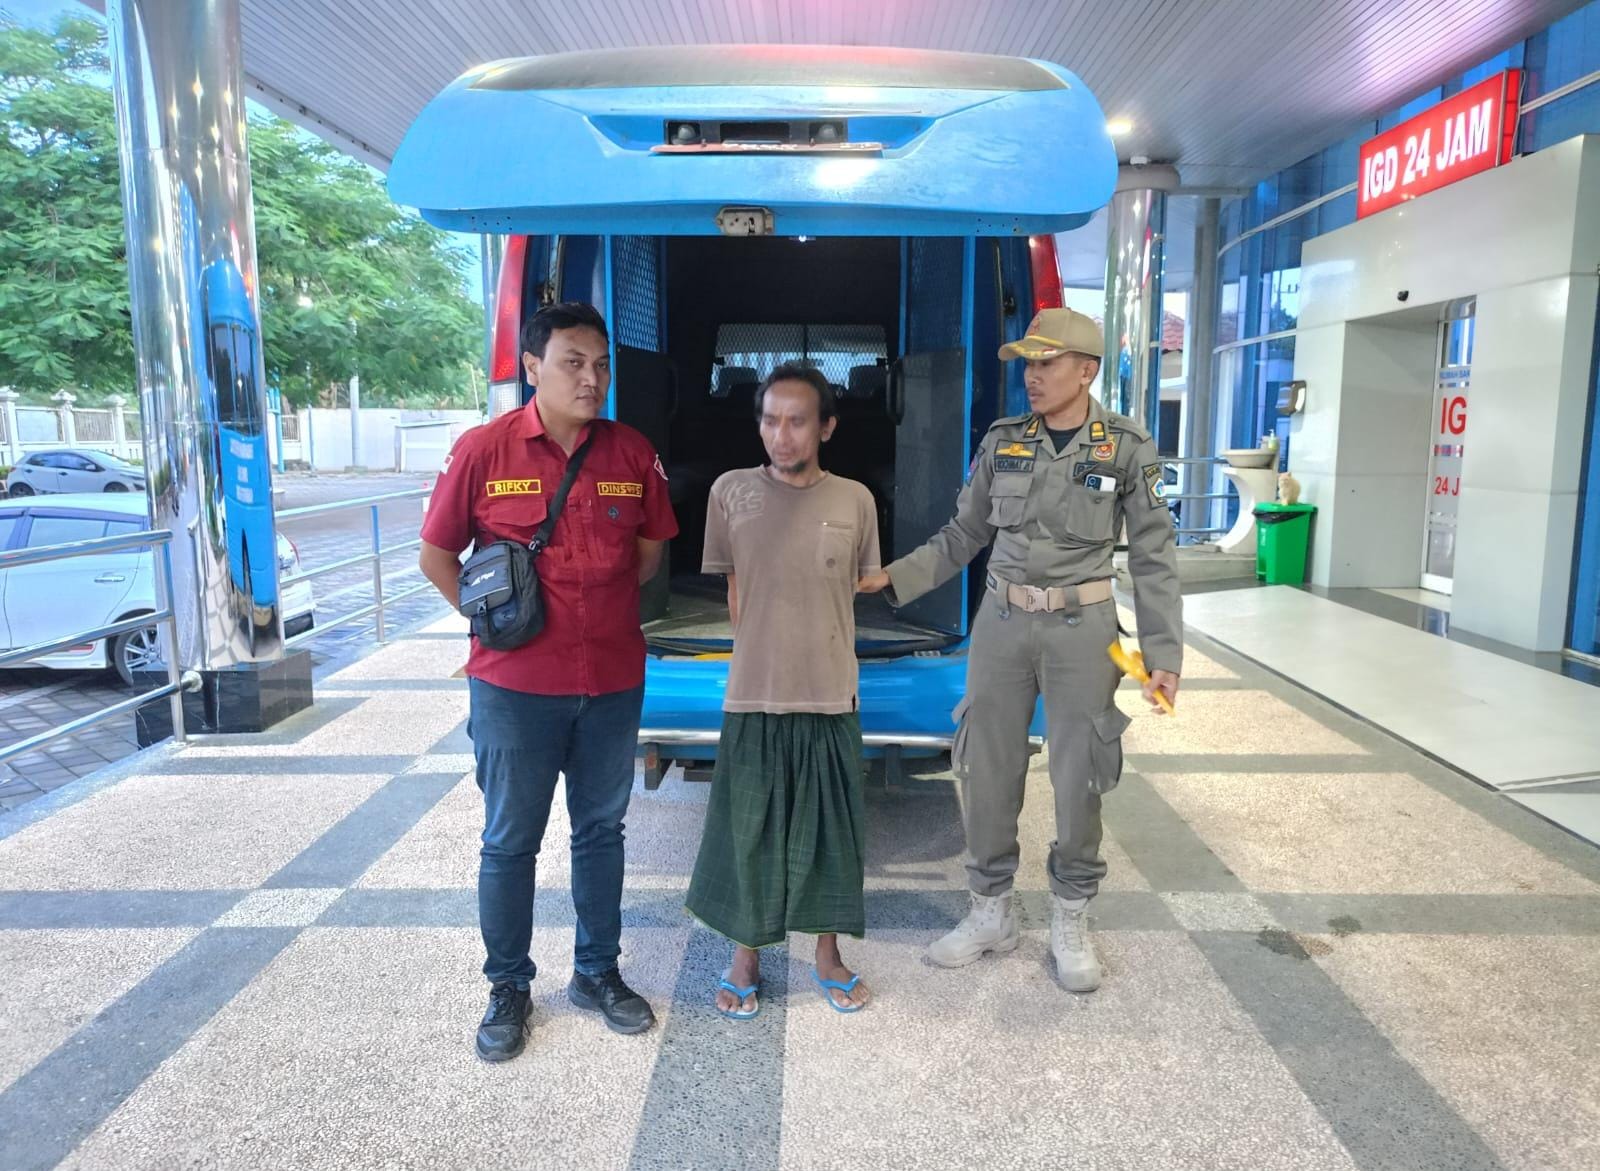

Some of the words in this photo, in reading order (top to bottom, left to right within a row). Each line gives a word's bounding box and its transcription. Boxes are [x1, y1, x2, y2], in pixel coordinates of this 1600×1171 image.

[1363, 145, 1398, 203] IGD
[1402, 128, 1431, 186] 24
[1436, 98, 1493, 171] JAM
[494, 481, 531, 494] RIFKY
[1434, 476, 1449, 496] 24
